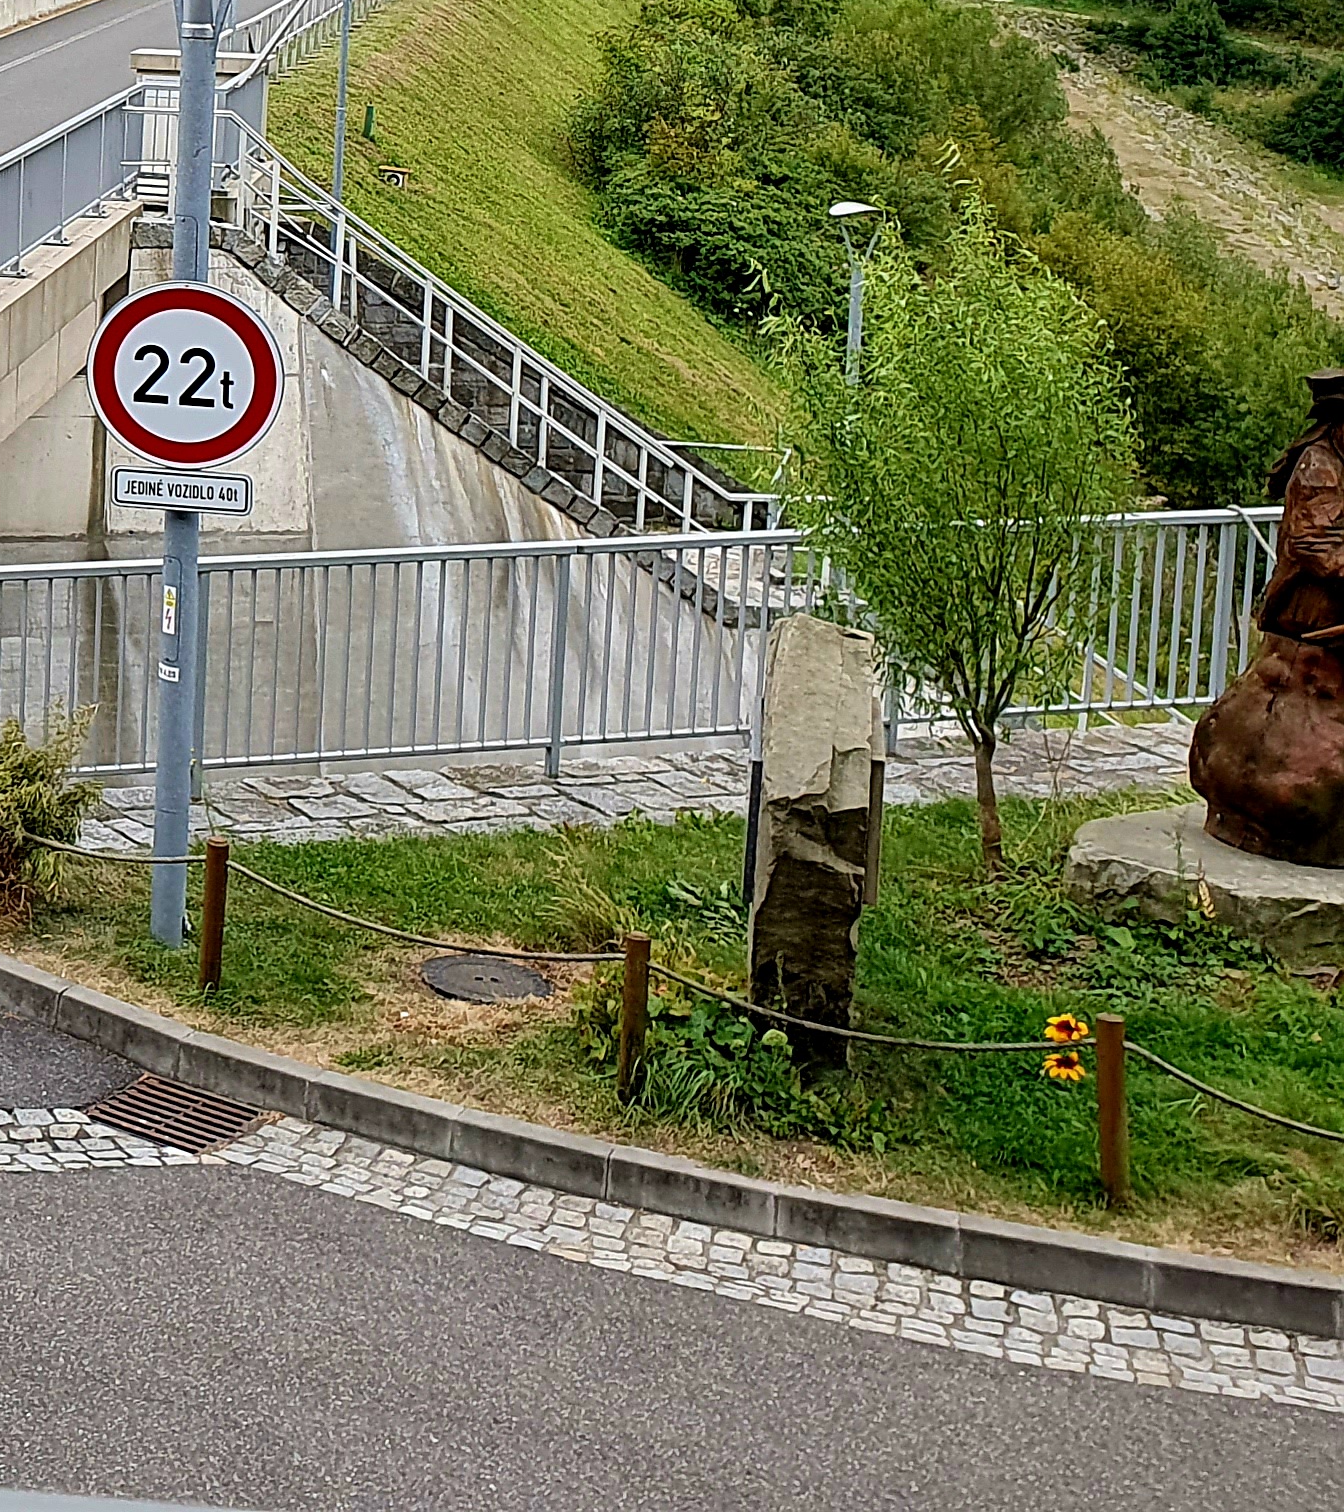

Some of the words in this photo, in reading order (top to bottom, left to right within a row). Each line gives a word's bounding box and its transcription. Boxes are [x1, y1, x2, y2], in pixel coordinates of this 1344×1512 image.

[133, 344, 234, 409] 22t
[124, 479, 163, 496] JEDINÉ
[168, 483, 214, 500] VOZIDLO
[218, 487, 238, 502] 40t
